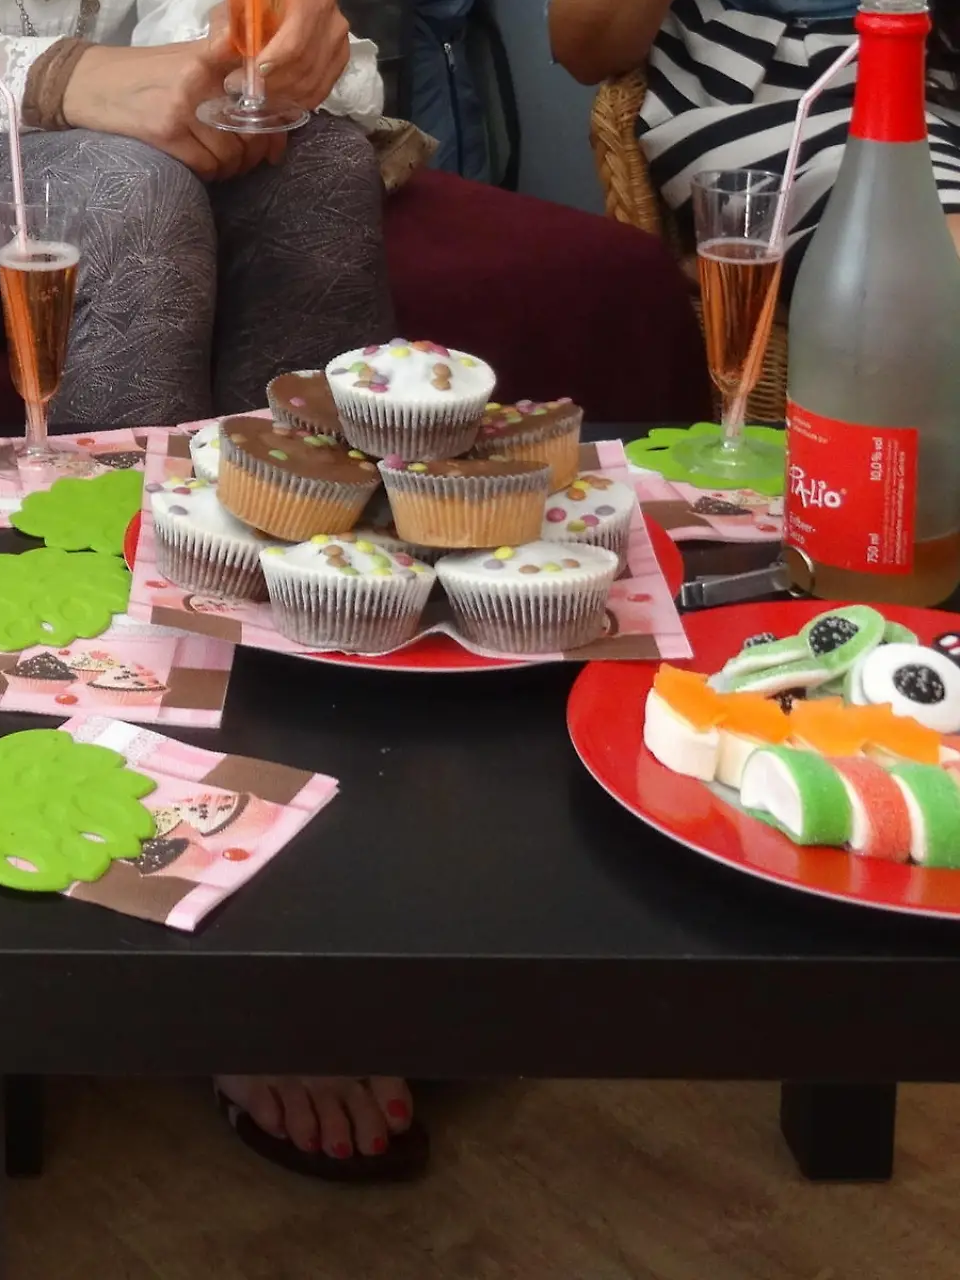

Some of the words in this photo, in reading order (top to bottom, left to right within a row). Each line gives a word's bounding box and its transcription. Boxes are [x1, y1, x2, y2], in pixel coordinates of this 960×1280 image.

[872, 436, 883, 450] vol
[868, 532, 880, 545] ml
[867, 545, 879, 563] 750
